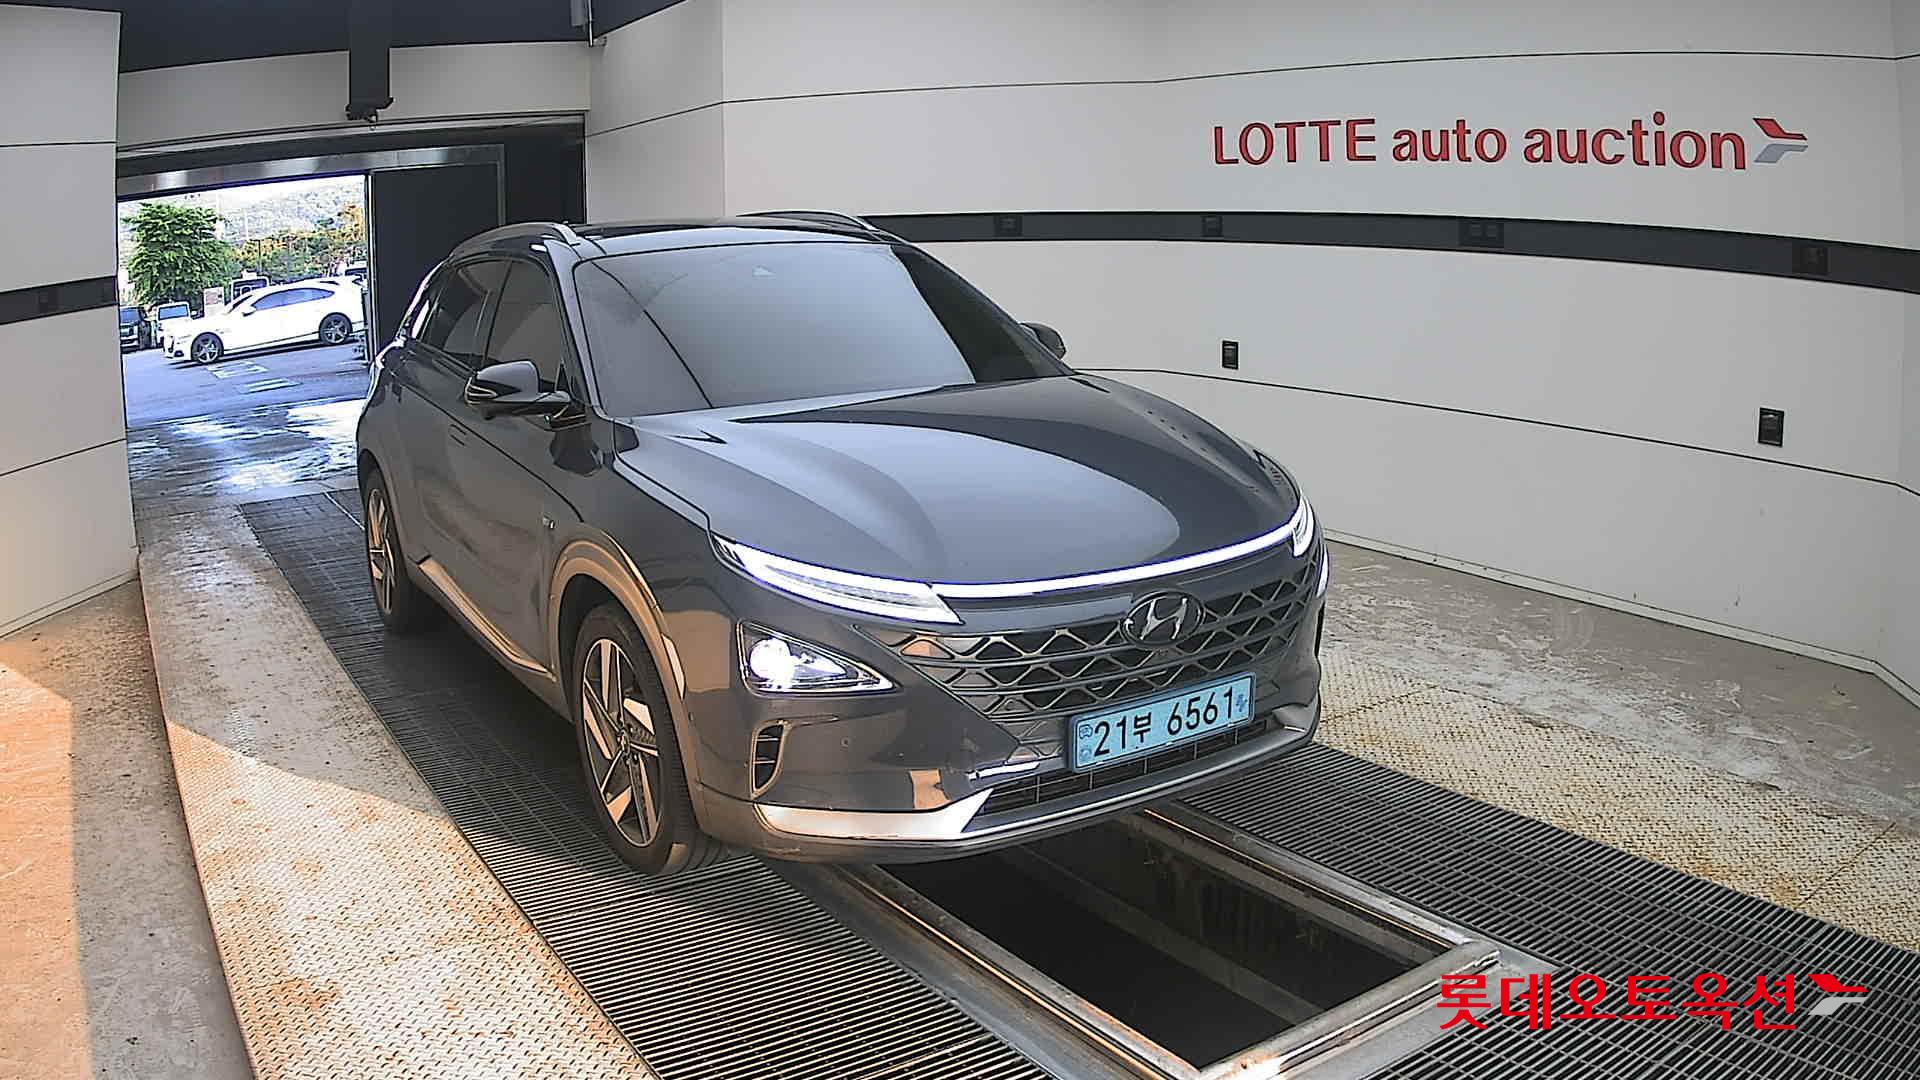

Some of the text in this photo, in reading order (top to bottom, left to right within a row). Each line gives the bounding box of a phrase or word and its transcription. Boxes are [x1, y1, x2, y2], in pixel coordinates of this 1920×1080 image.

[1214, 111, 1747, 169] LOTTE auto auction
[1093, 686, 1233, 757] 21부 6561
